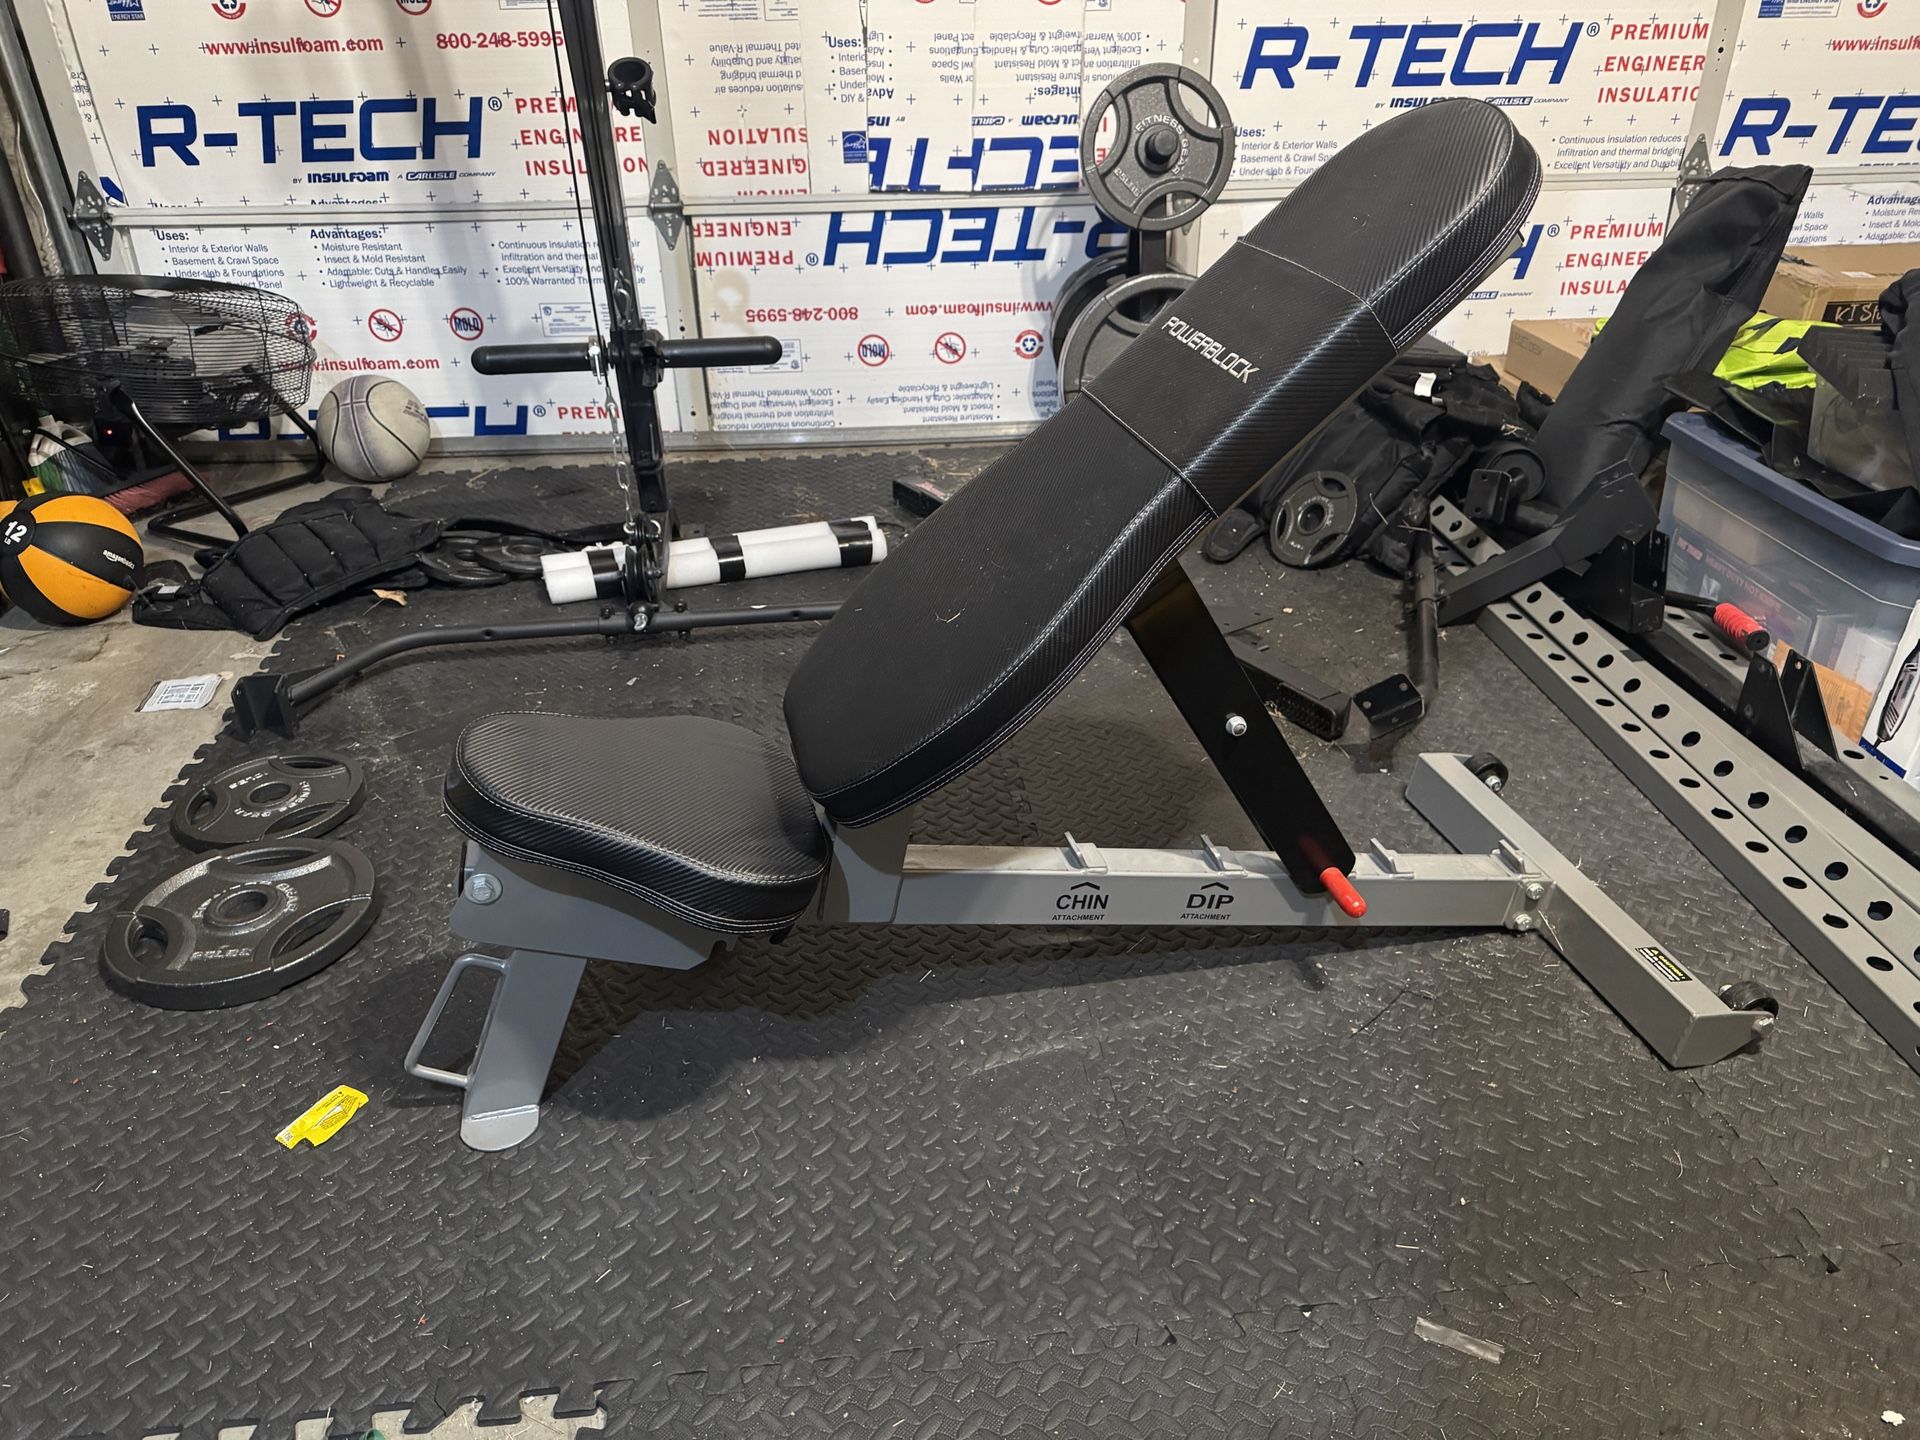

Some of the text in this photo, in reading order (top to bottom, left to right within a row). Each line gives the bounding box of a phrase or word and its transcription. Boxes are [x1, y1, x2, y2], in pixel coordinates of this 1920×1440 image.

[1611, 22, 1709, 40] PREMIUM
[207, 36, 384, 55] www.insulfoam.com
[745, 43, 782, 52] Thermal
[829, 37, 861, 48] Uses:
[1832, 35, 1920, 51] www.insulf
[1604, 56, 1706, 72] ENGINEER
[759, 71, 794, 80] thermal
[728, 85, 764, 94] reduces
[1598, 86, 1700, 104] INSULATIO
[1719, 95, 1920, 156] R-TE
[708, 127, 808, 146] SULATION
[1559, 134, 1682, 145] Continuous insulation reduces
[1135, 114, 1190, 175] FITNESS GEAR
[1241, 141, 1271, 151] Interior
[1282, 141, 1314, 150] Exterior
[1315, 141, 1338, 149] Walls
[1240, 154, 1284, 163] Basement
[1293, 153, 1316, 162] Crawl
[1557, 146, 1684, 159] infiltration and thermal bridging
[702, 158, 807, 176] GINEERED
[1634, 159, 1649, 169] and
[406, 170, 456, 181] CARLISLE
[1871, 210, 1907, 218] Moisture
[1868, 221, 1892, 229] Insect
[157, 228, 382, 241] Uses: Advantages:
[1570, 223, 1664, 240] PREMIUM
[168, 243, 269, 253] Interior & Exterior Walls
[321, 242, 402, 252] Moisture Resistant
[499, 240, 546, 250] Continuous
[172, 256, 280, 268] Basement & Crawl Space
[324, 253, 426, 264] Insect & Mold Resistant
[501, 252, 545, 262] infiltration
[547, 253, 564, 262] and
[697, 250, 794, 267] PREMIUM
[1565, 252, 1647, 268] ENGINEE
[231, 268, 285, 278] Foundations
[404, 266, 441, 276] Handles
[443, 265, 468, 277] Easily
[258, 280, 283, 290] Panel
[329, 278, 435, 290] Lightweight & Recyclable
[505, 276, 575, 286] 100% Warranted
[1560, 282, 1627, 296] INSULA
[745, 307, 859, 323] 800-248-5995
[1161, 316, 1260, 384] POWERBLOCK
[4, 520, 28, 543] 12
[1056, 894, 1109, 910] CHIN
[1186, 893, 1235, 909] DIP
[1179, 913, 1232, 921] ATTACHMENT
